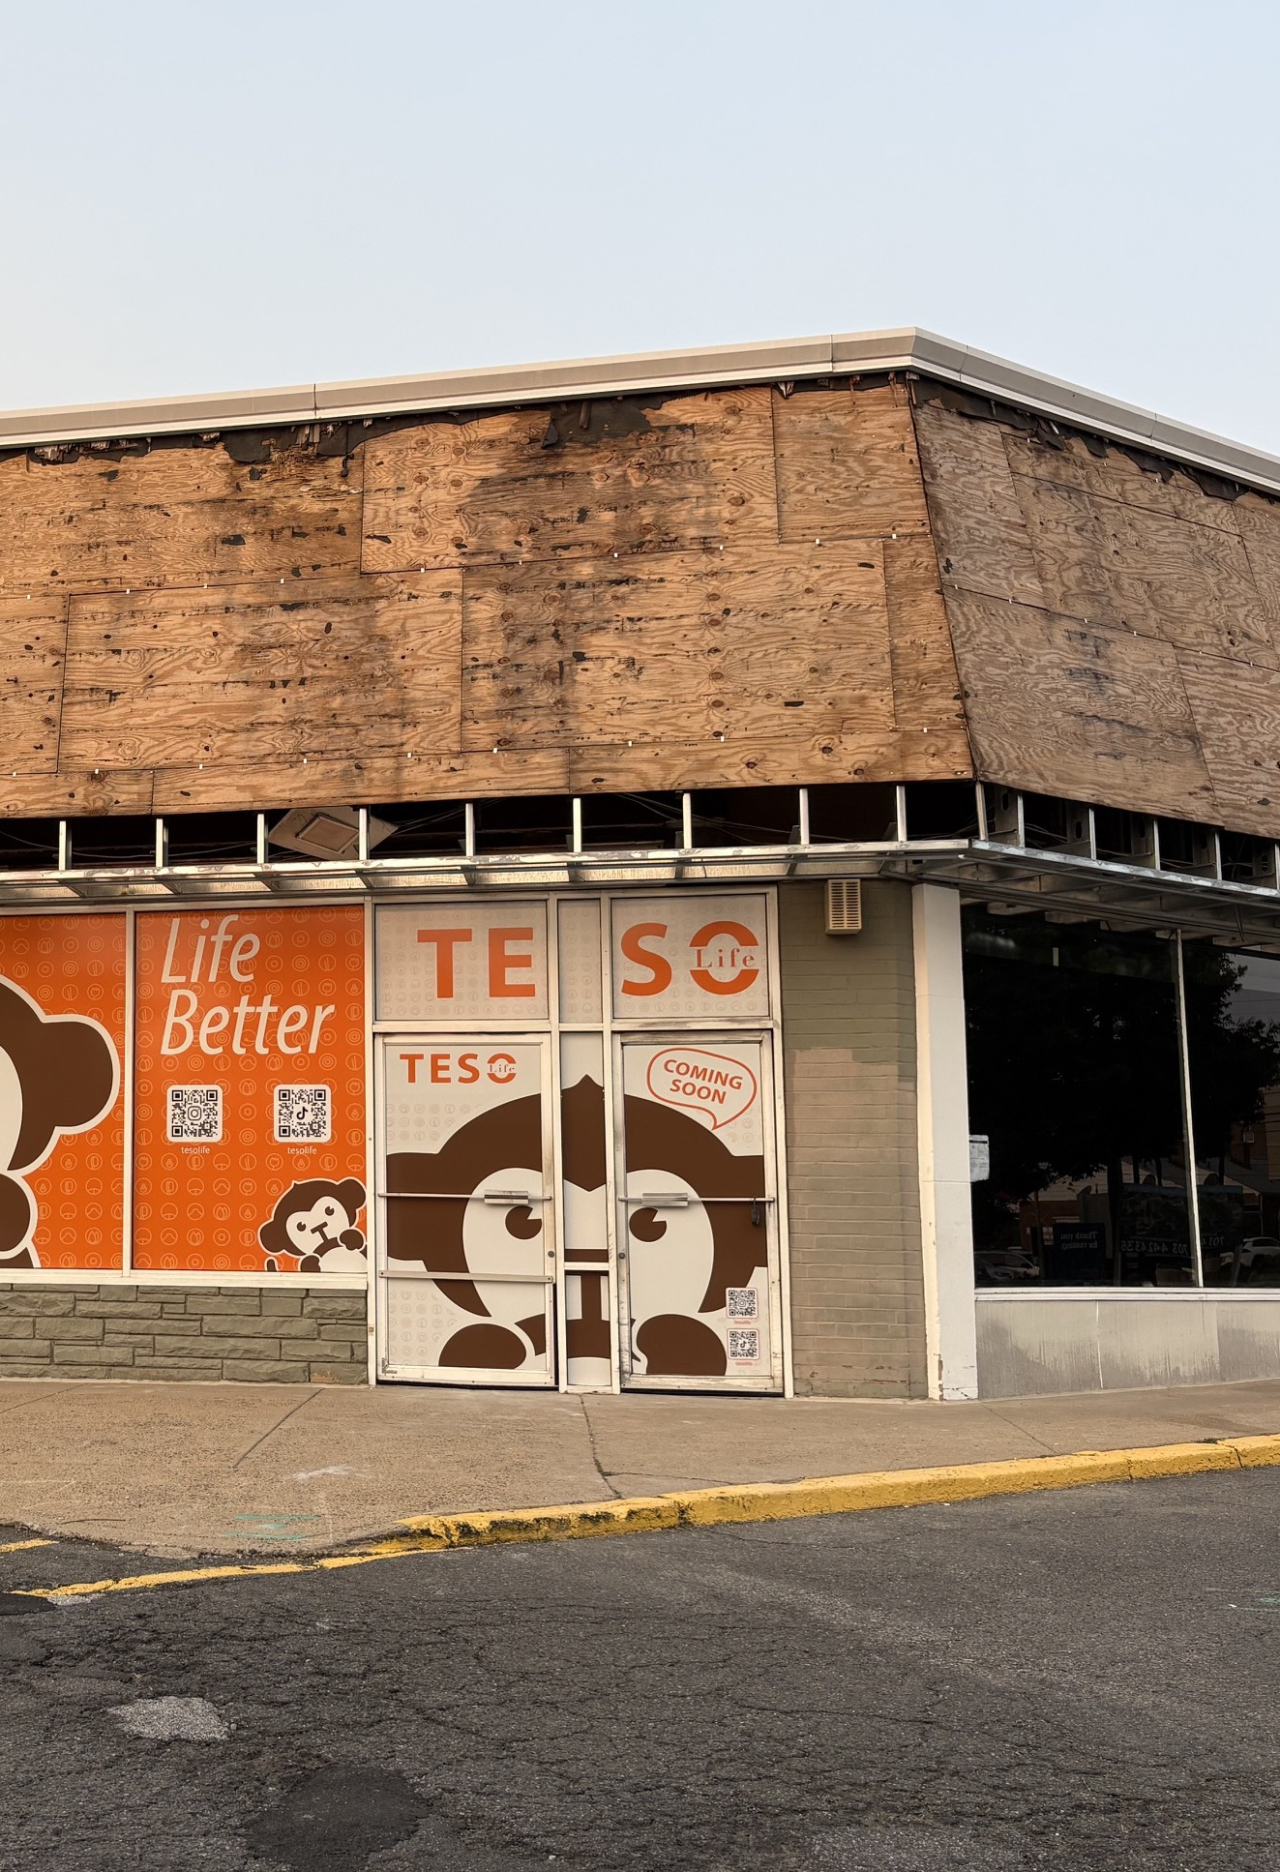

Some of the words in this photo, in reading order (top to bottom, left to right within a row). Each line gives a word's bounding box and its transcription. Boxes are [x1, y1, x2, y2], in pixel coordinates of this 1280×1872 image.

[160, 913, 261, 984] Life
[417, 920, 760, 999] TESO
[694, 946, 756, 969] Life
[159, 988, 336, 1056] Better
[399, 1053, 517, 1084] TESO
[488, 1062, 517, 1074] Life
[662, 1058, 744, 1091] COMING
[669, 1078, 727, 1105] SOON
[180, 1144, 211, 1155] tesolife
[286, 1144, 318, 1155] tesolife
